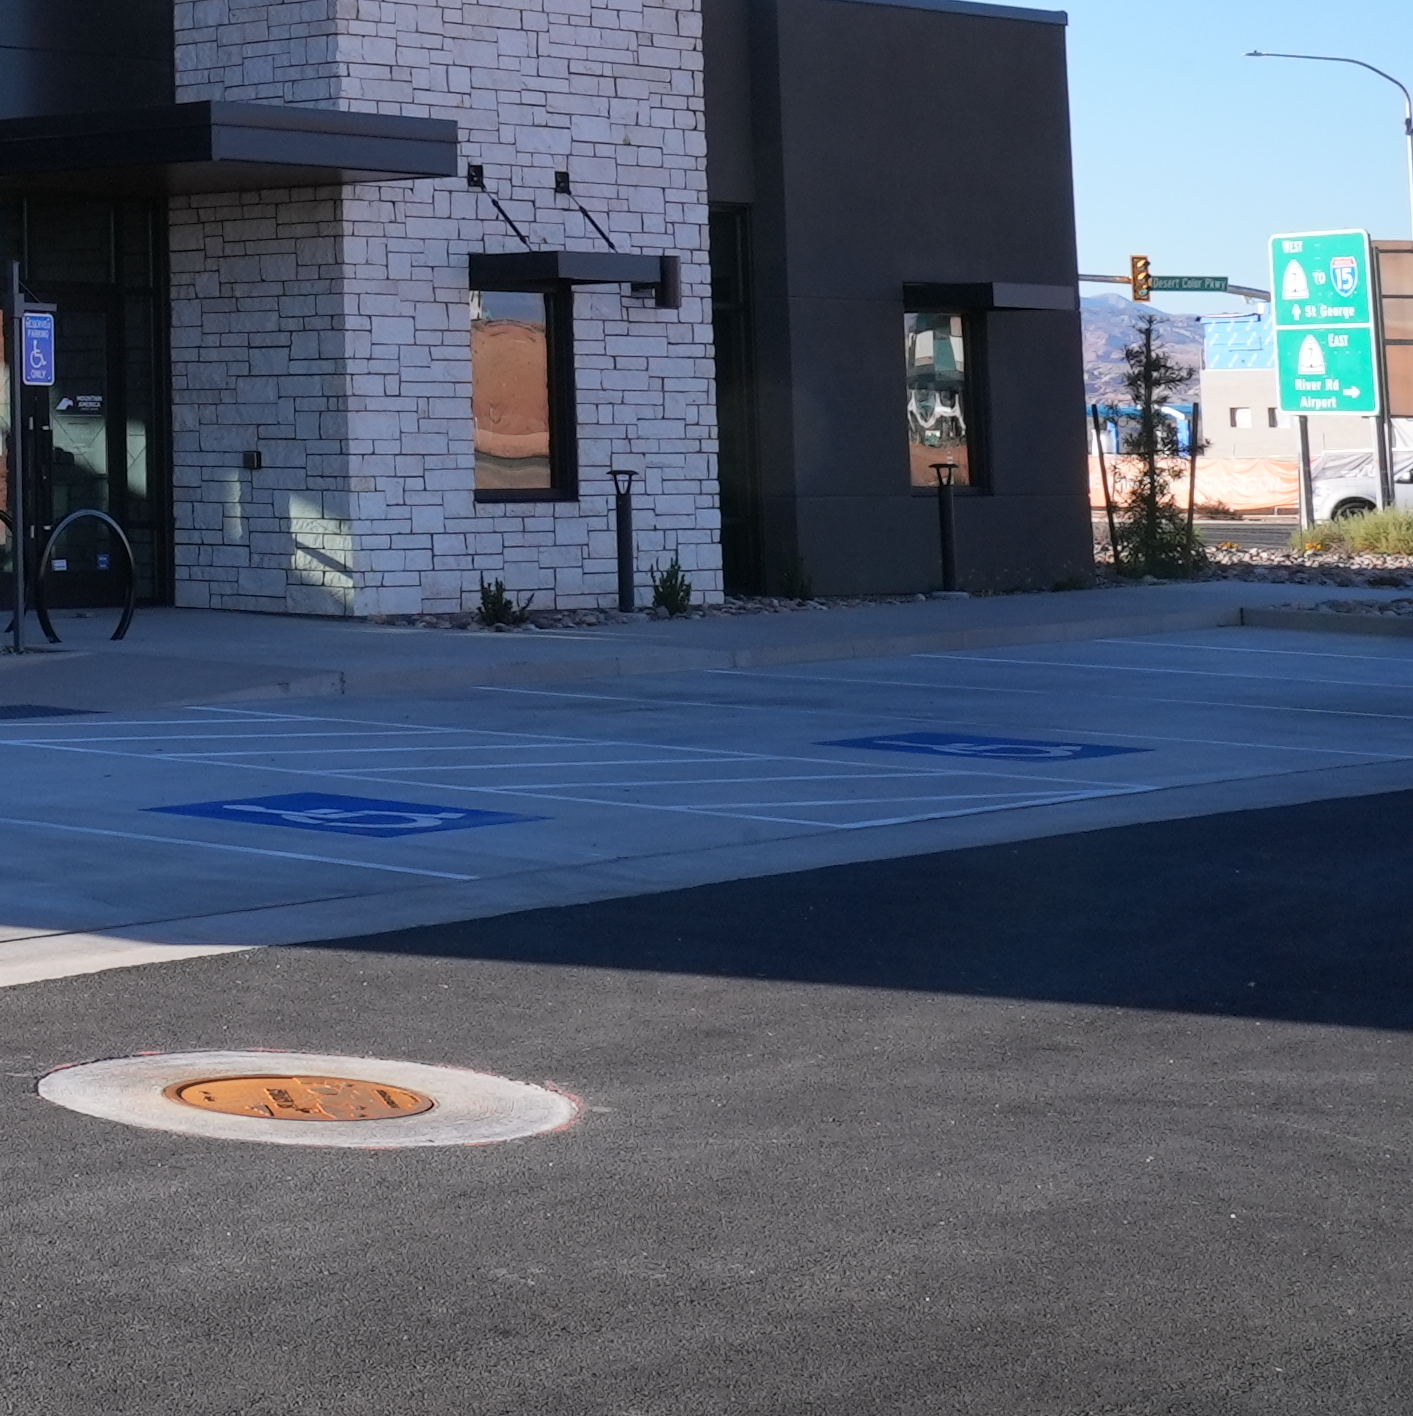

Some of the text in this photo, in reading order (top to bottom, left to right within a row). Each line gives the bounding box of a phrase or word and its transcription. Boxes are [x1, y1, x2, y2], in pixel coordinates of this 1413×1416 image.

[1281, 240, 1303, 254] WEST
[1153, 277, 1226, 290] Desert Color Pkwy
[1312, 270, 1327, 285] TO
[1334, 267, 1354, 290] 15
[1304, 304, 1355, 319] St George
[1327, 333, 1349, 347] EAST
[30, 369, 47, 379] ONLY
[1294, 378, 1340, 391] River Rd
[1300, 396, 1337, 410] Airport
